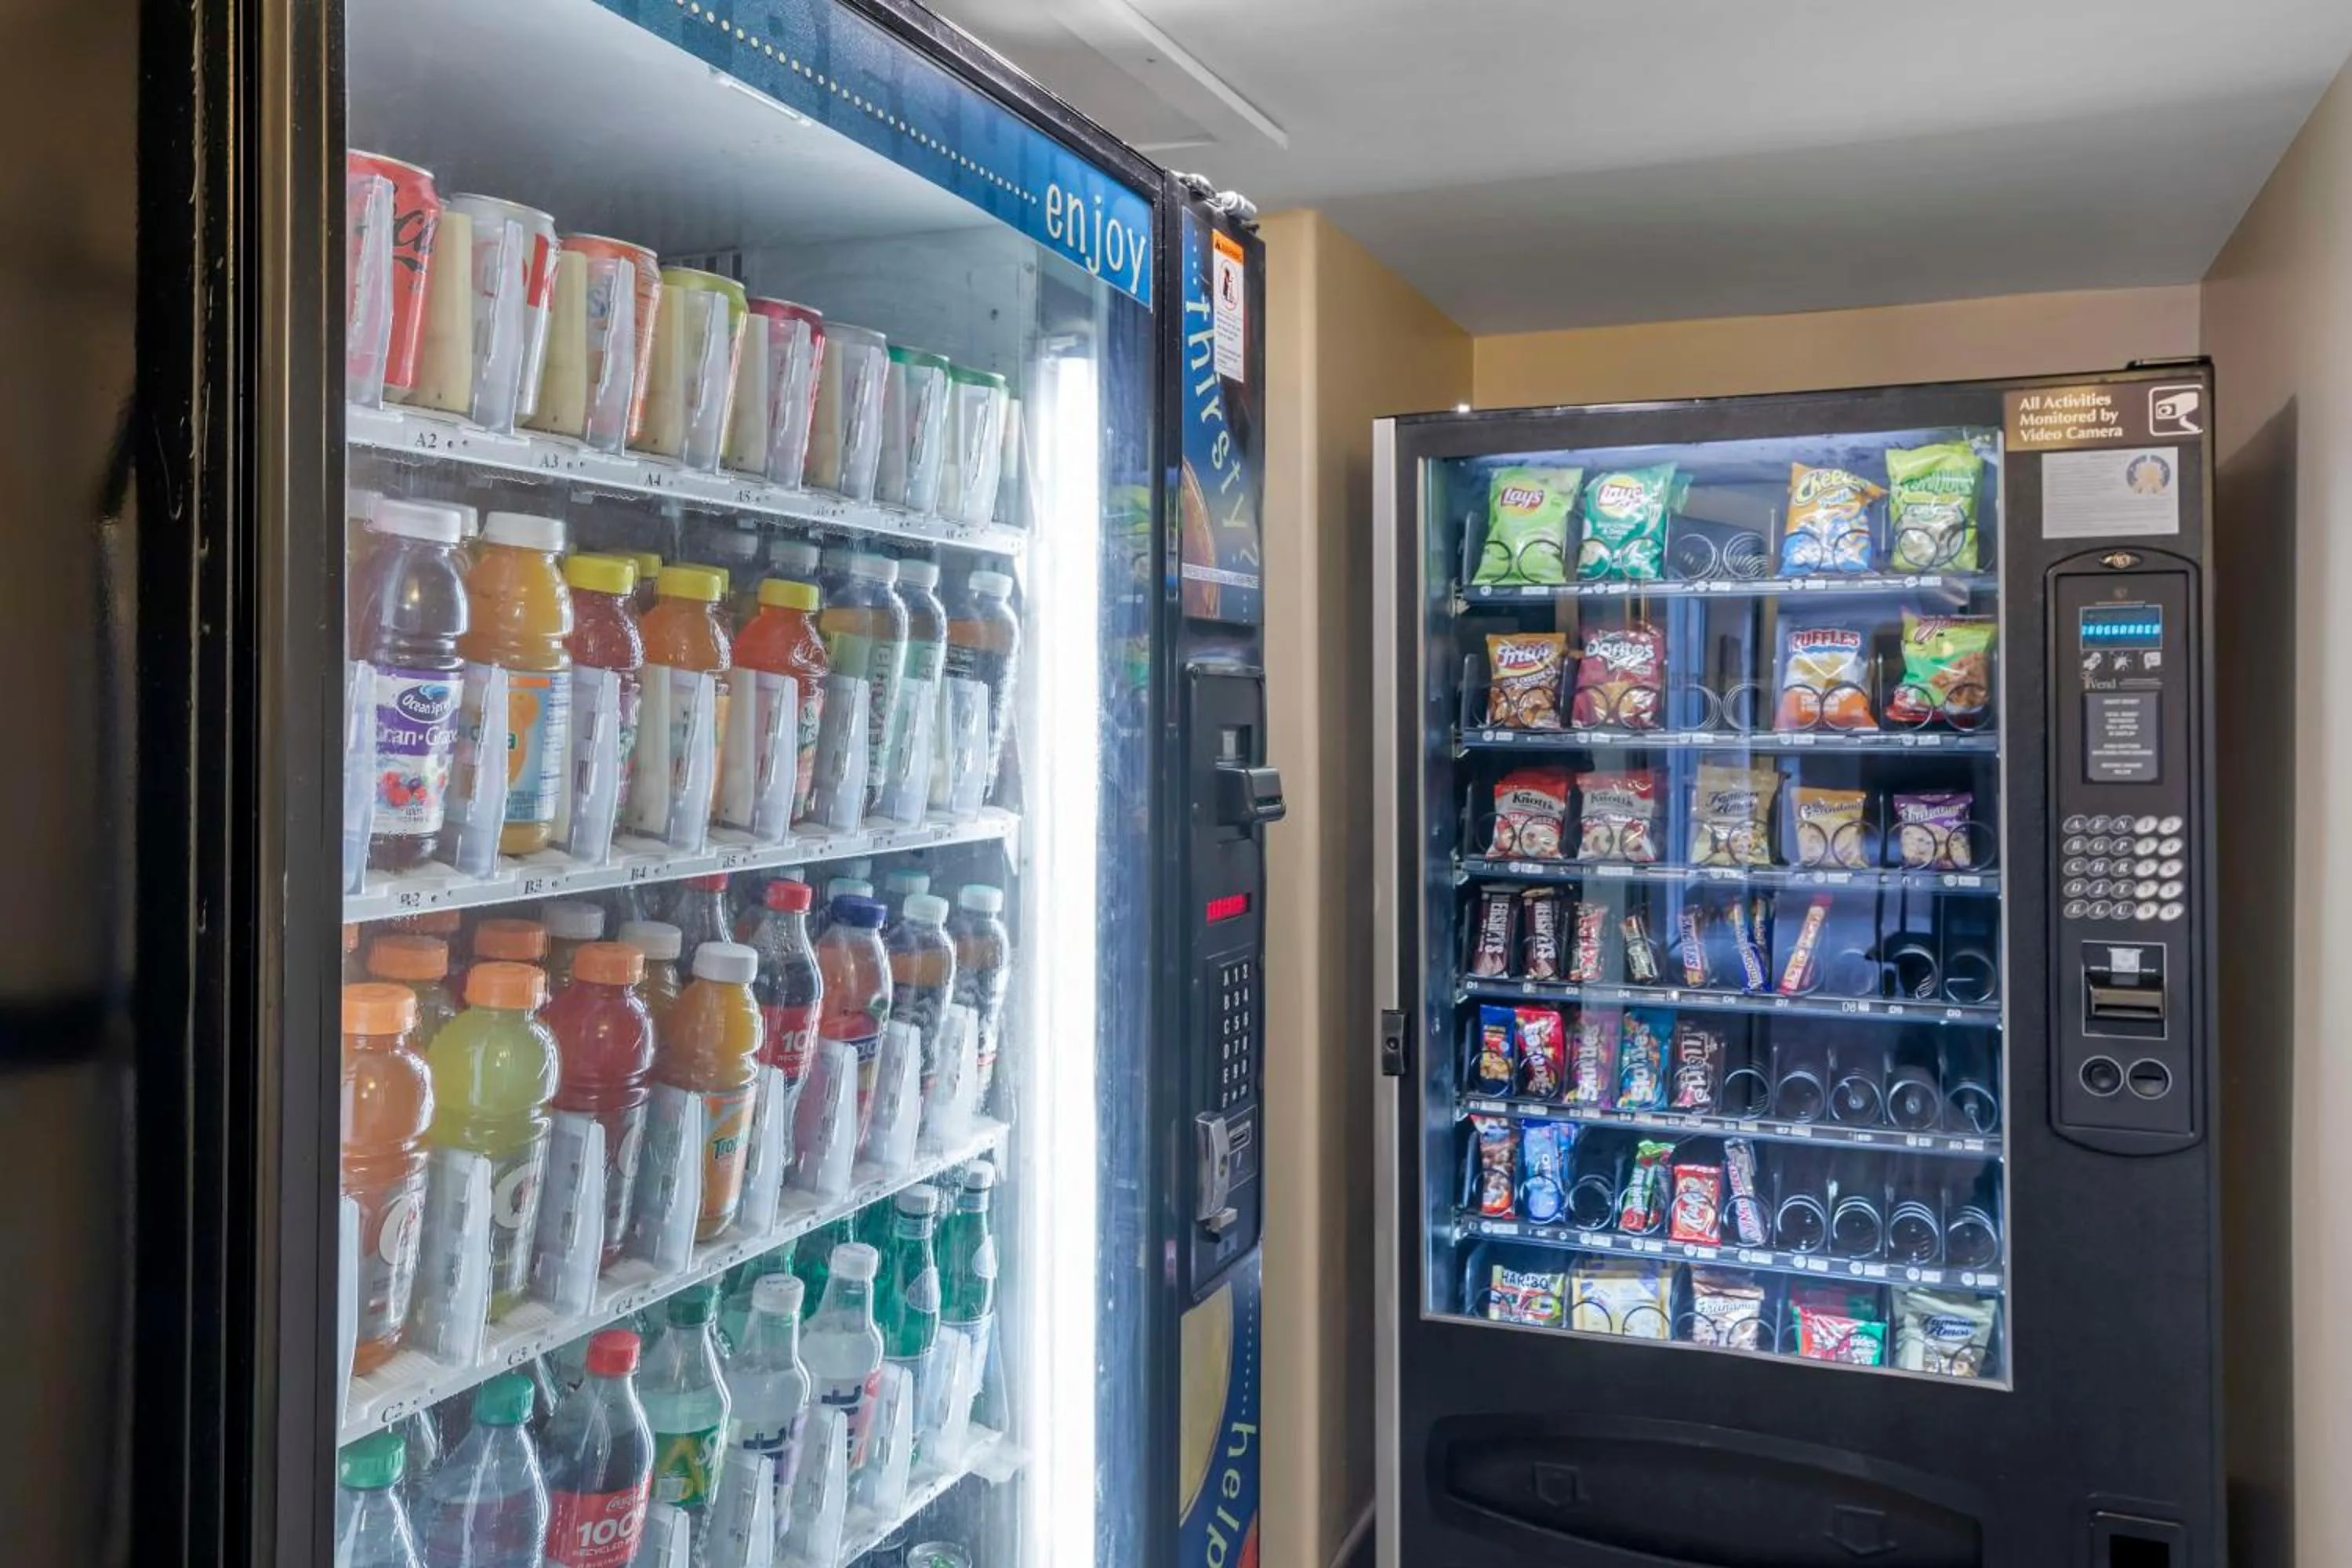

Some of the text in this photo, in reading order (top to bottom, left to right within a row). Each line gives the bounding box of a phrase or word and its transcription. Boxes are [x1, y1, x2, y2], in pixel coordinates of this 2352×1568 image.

[1045, 183, 1146, 295] enjoy
[2020, 394, 2111, 411] All Activities
[2020, 408, 2118, 426] Monitored by
[415, 433, 437, 448] A2
[2020, 425, 2123, 443] Video Camera
[539, 453, 559, 468] A3
[1585, 639, 1655, 659] Doritos
[402, 694, 430, 714] Ocean
[1223, 969, 1230, 987] A
[1233, 967, 1239, 983] 1
[1243, 964, 1248, 980] 2
[1224, 994, 1230, 1011] B
[1234, 990, 1240, 1007] 3
[1224, 1018, 1230, 1035] C
[1234, 1014, 1240, 1031] 5
[1224, 1043, 1230, 1060] D
[1233, 1039, 1240, 1054] 7
[1577, 1025, 1600, 1102] Skittles
[1223, 1067, 1229, 1084] E
[1501, 1269, 1549, 1290] HARIBO
[1206, 1421, 1257, 1568] help
